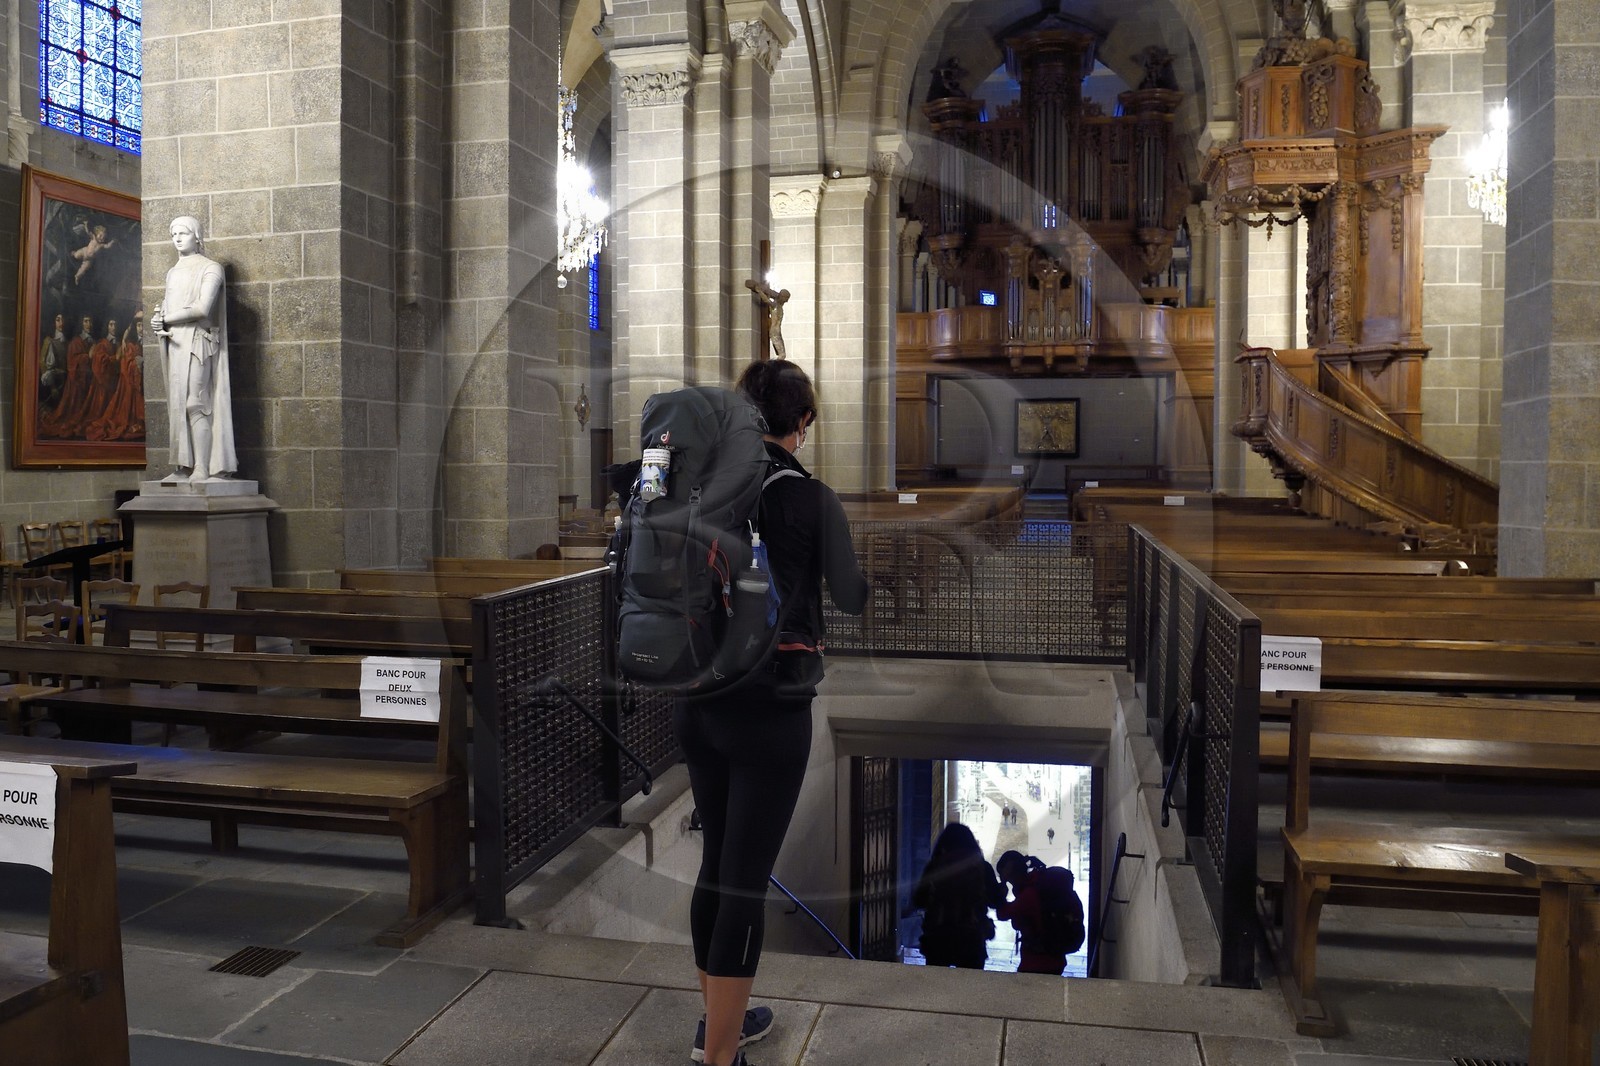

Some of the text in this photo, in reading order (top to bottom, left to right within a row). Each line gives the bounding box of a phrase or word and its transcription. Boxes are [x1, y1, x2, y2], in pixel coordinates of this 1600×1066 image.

[1261, 650, 1307, 659] ANC POUR
[1267, 663, 1314, 672] PERSONNE
[376, 669, 426, 679] BANC POUR
[388, 684, 412, 692] DEUX
[375, 695, 427, 706] PERSONNES
[3, 789, 38, 805] POUR
[0, 813, 50, 830] RSONNE
